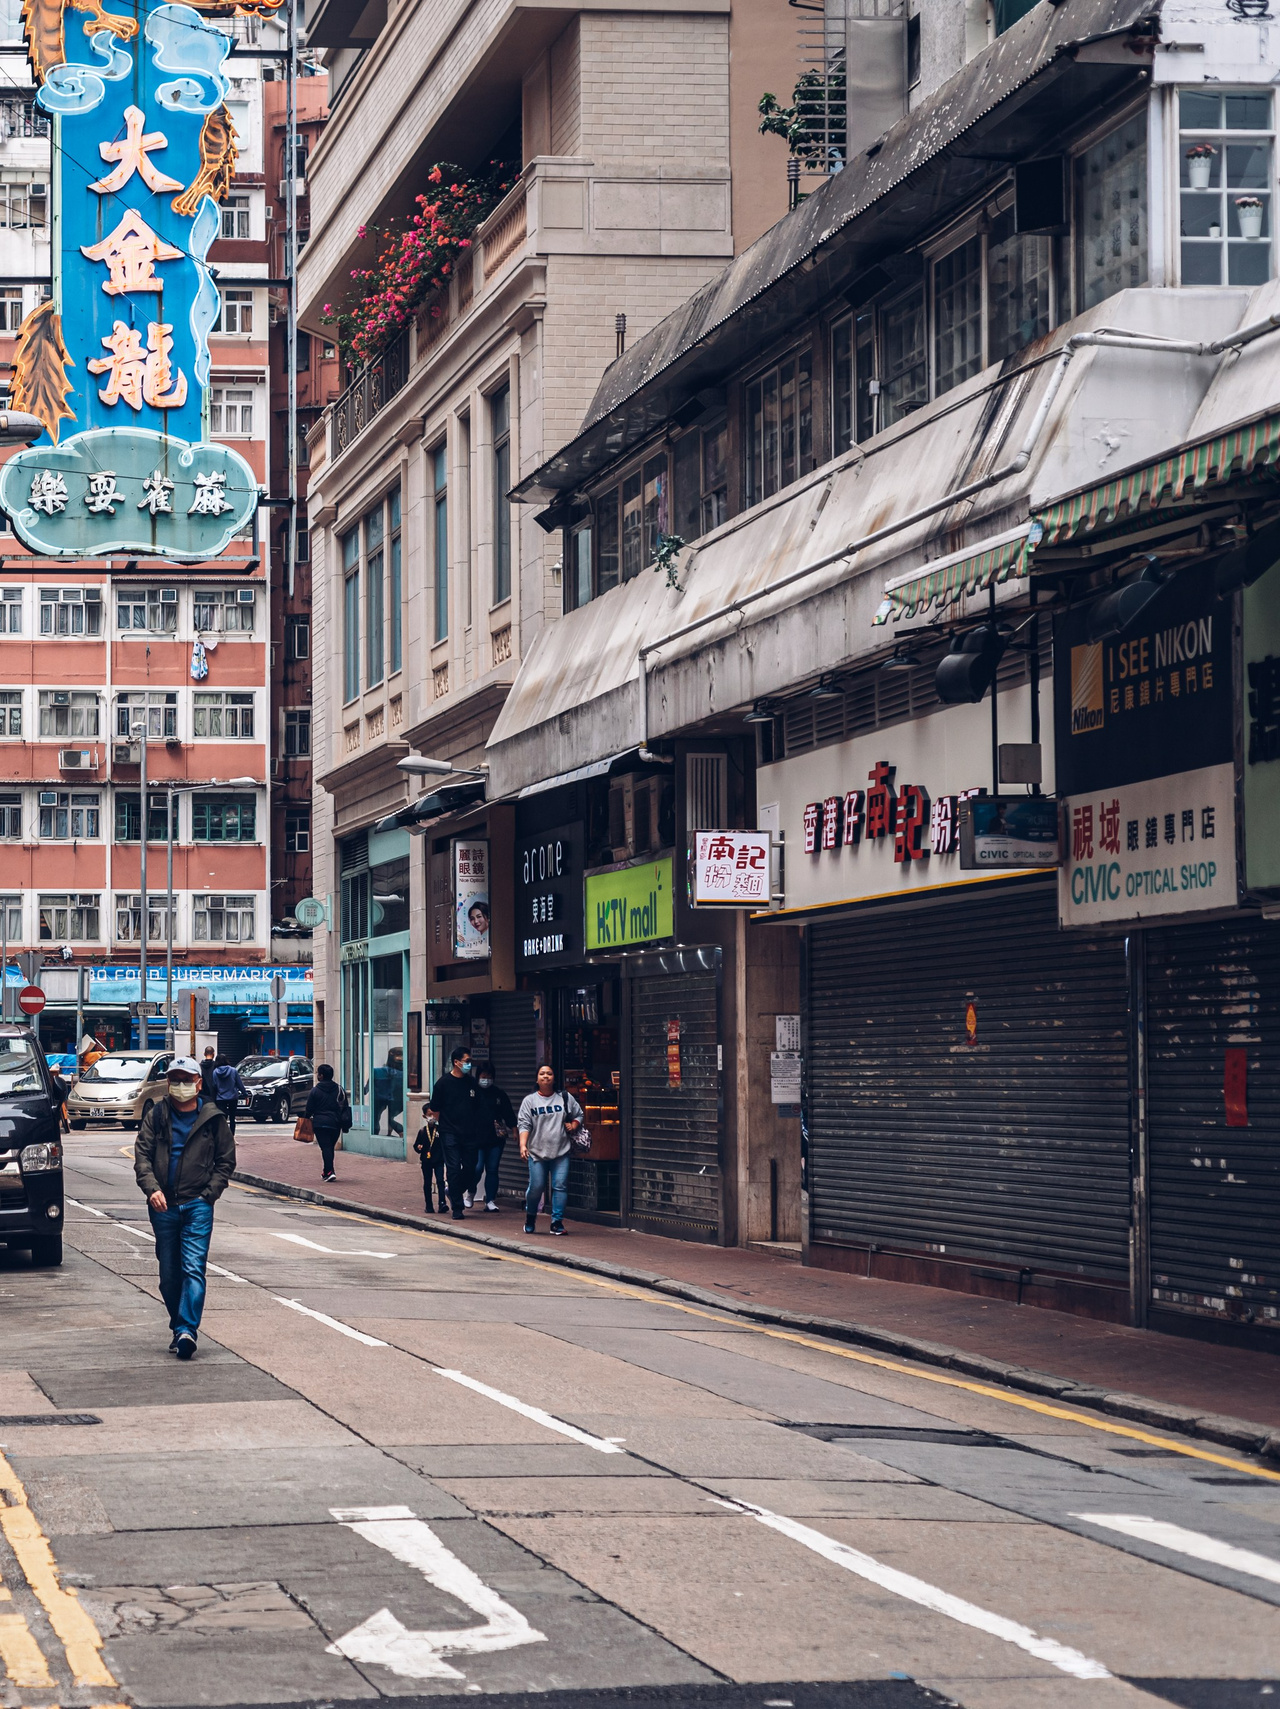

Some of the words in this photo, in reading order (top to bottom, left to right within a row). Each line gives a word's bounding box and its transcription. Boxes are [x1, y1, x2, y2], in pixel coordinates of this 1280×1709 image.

[80, 104, 187, 411] 大金龍
[1110, 647, 1114, 682] I
[1120, 637, 1150, 679] SEE
[1155, 615, 1213, 669] NIKON
[1110, 661, 1214, 715] 尼康鏡片專門店
[1073, 706, 1103, 732] Nikon
[1073, 799, 1121, 862] 視域
[1127, 806, 1216, 852] 眼鏡專門店
[458, 862, 486, 875] 眼鏡
[523, 840, 562, 884] arome
[708, 836, 766, 870] 南記
[980, 850, 1009, 859] CIVIC
[1012, 851, 1036, 859] OPTICAL
[1038, 851, 1054, 859] SHOP
[704, 863, 764, 898] 粉麵
[1071, 861, 1121, 905] CIVIC
[1126, 867, 1178, 898] OPTICAL
[1180, 861, 1217, 891] SHOP
[532, 894, 554, 924] 東海堂
[597, 897, 627, 944] HKTV
[630, 890, 657, 939] mall
[115, 969, 160, 981] FOOD
[170, 969, 292, 982] SUPERMARKET
[531, 1105, 563, 1117] NEED
